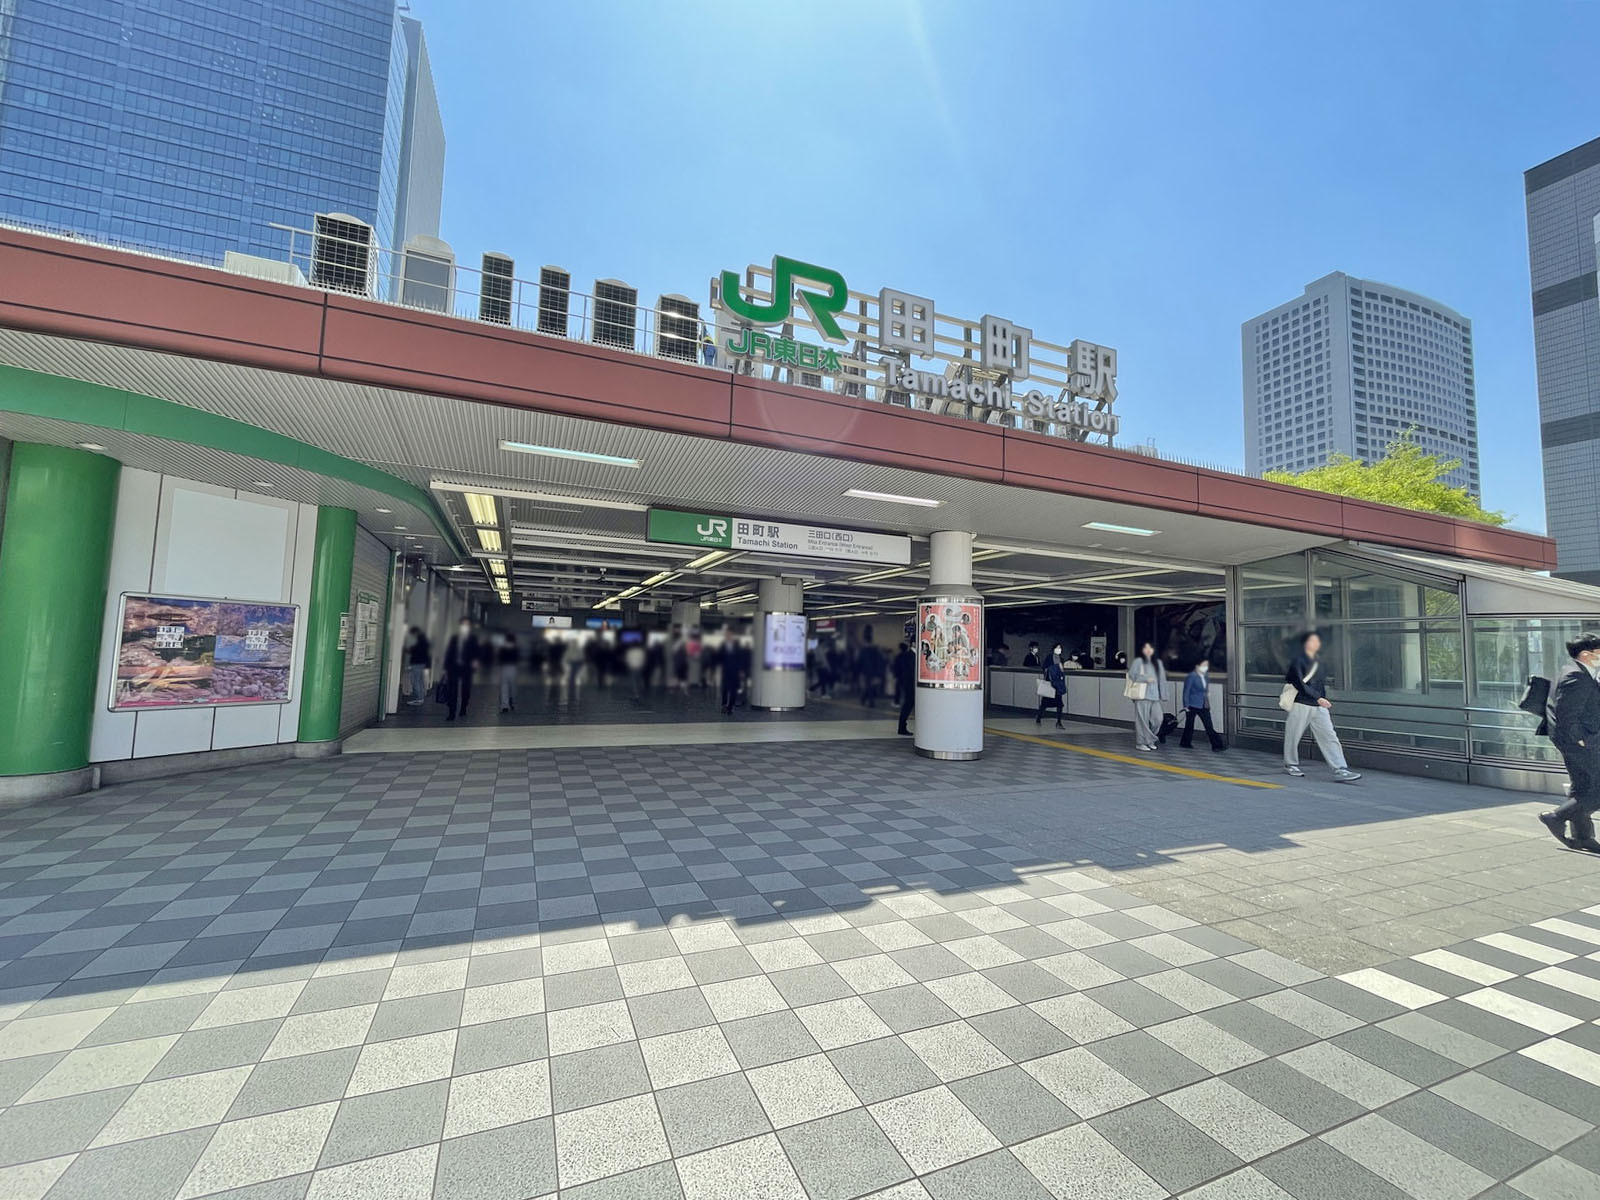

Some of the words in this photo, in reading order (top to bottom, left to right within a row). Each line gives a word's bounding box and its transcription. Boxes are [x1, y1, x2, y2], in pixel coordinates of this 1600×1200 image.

[720, 254, 849, 344] JR
[727, 328, 842, 371] JR東日本
[879, 287, 1118, 403] 田町駅
[879, 357, 1012, 409] Tamachi
[1023, 389, 1120, 435] Station
[697, 519, 727, 537] JR
[737, 537, 770, 547] Tamachi
[771, 540, 798, 549] Station
[738, 522, 779, 538] 田町駅
